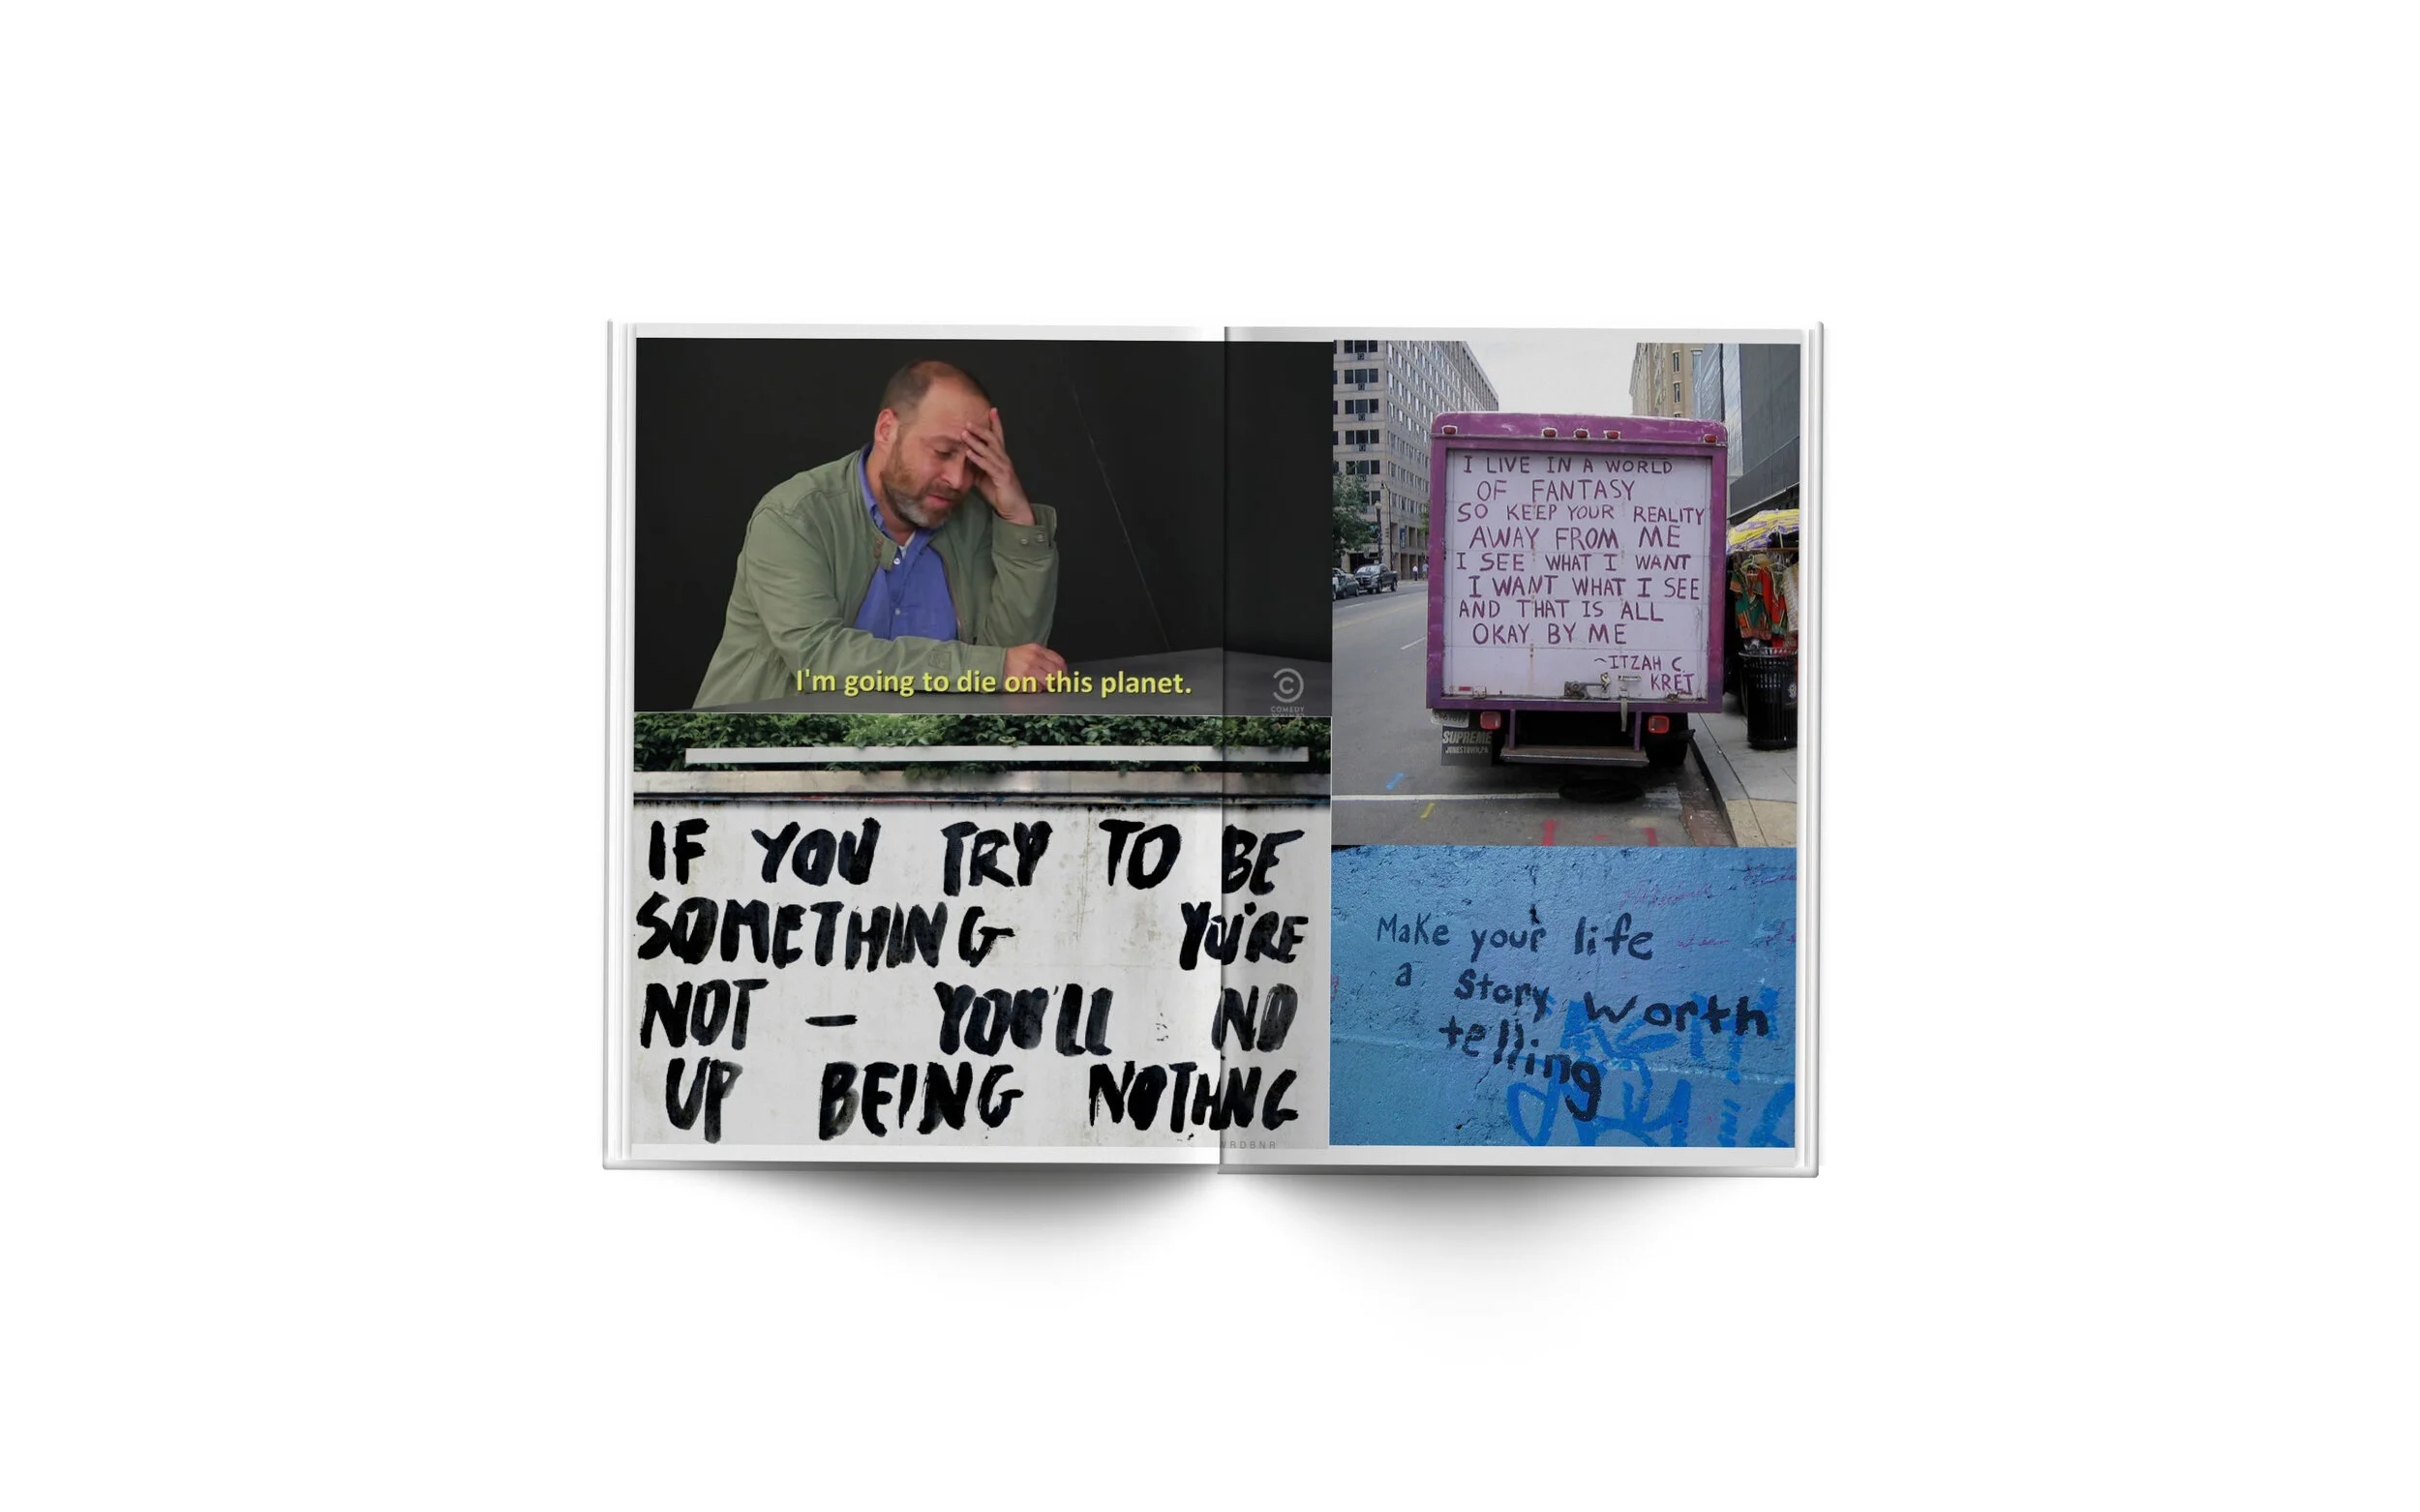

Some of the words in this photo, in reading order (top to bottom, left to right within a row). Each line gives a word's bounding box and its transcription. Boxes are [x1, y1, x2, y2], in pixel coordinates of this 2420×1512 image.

[1464, 455, 1472, 473] I
[1486, 456, 1530, 474] LIVE
[1547, 456, 1572, 473] IN
[1583, 458, 1593, 473] A
[1605, 459, 1673, 474] WORLD
[1476, 480, 1507, 501] OF
[1531, 478, 1635, 502] FANTASY
[1457, 502, 1488, 523] SO
[1506, 504, 1558, 522] KEEP
[1567, 504, 1615, 521] YOUR
[1633, 505, 1705, 526] REALITY
[1468, 526, 1540, 550] AWAY
[1556, 527, 1618, 550] FROM
[1639, 525, 1681, 548] ME
[1456, 552, 1467, 570] I
[1479, 552, 1525, 571] SEE
[1545, 553, 1591, 572] WHAT
[1603, 553, 1618, 571] I
[1635, 554, 1691, 571] WANT
[1468, 575, 1482, 598] I
[1492, 574, 1558, 597] WANT
[1572, 576, 1626, 597] WHAT
[1637, 577, 1652, 597] I
[1664, 577, 1701, 600] SEE
[1459, 599, 1500, 619] AND
[1516, 599, 1570, 619] THAT
[1583, 600, 1604, 619] IS
[1620, 601, 1664, 621] ALL
[1472, 622, 1530, 645] OKAY
[1548, 621, 1577, 645] BY
[1588, 623, 1627, 645] ME
[1650, 673, 1695, 692] KRET
[1442, 730, 1492, 744] SUPREME
[649, 818, 710, 885] IF
[751, 817, 881, 887] YOU
[940, 821, 1053, 896] TRY
[1099, 819, 1182, 890] TO
[1222, 824, 1305, 895] BE
[636, 892, 1015, 972] SOMETHING
[1469, 922, 1547, 962] your
[1574, 912, 1654, 960] life
[1394, 962, 1413, 987] a
[640, 979, 770, 1050] NOT
[933, 982, 1113, 1056] YOU'LL
[1438, 1014, 1602, 1122] telling
[666, 1057, 742, 1143] UP
[819, 1061, 1023, 1141] BEING
